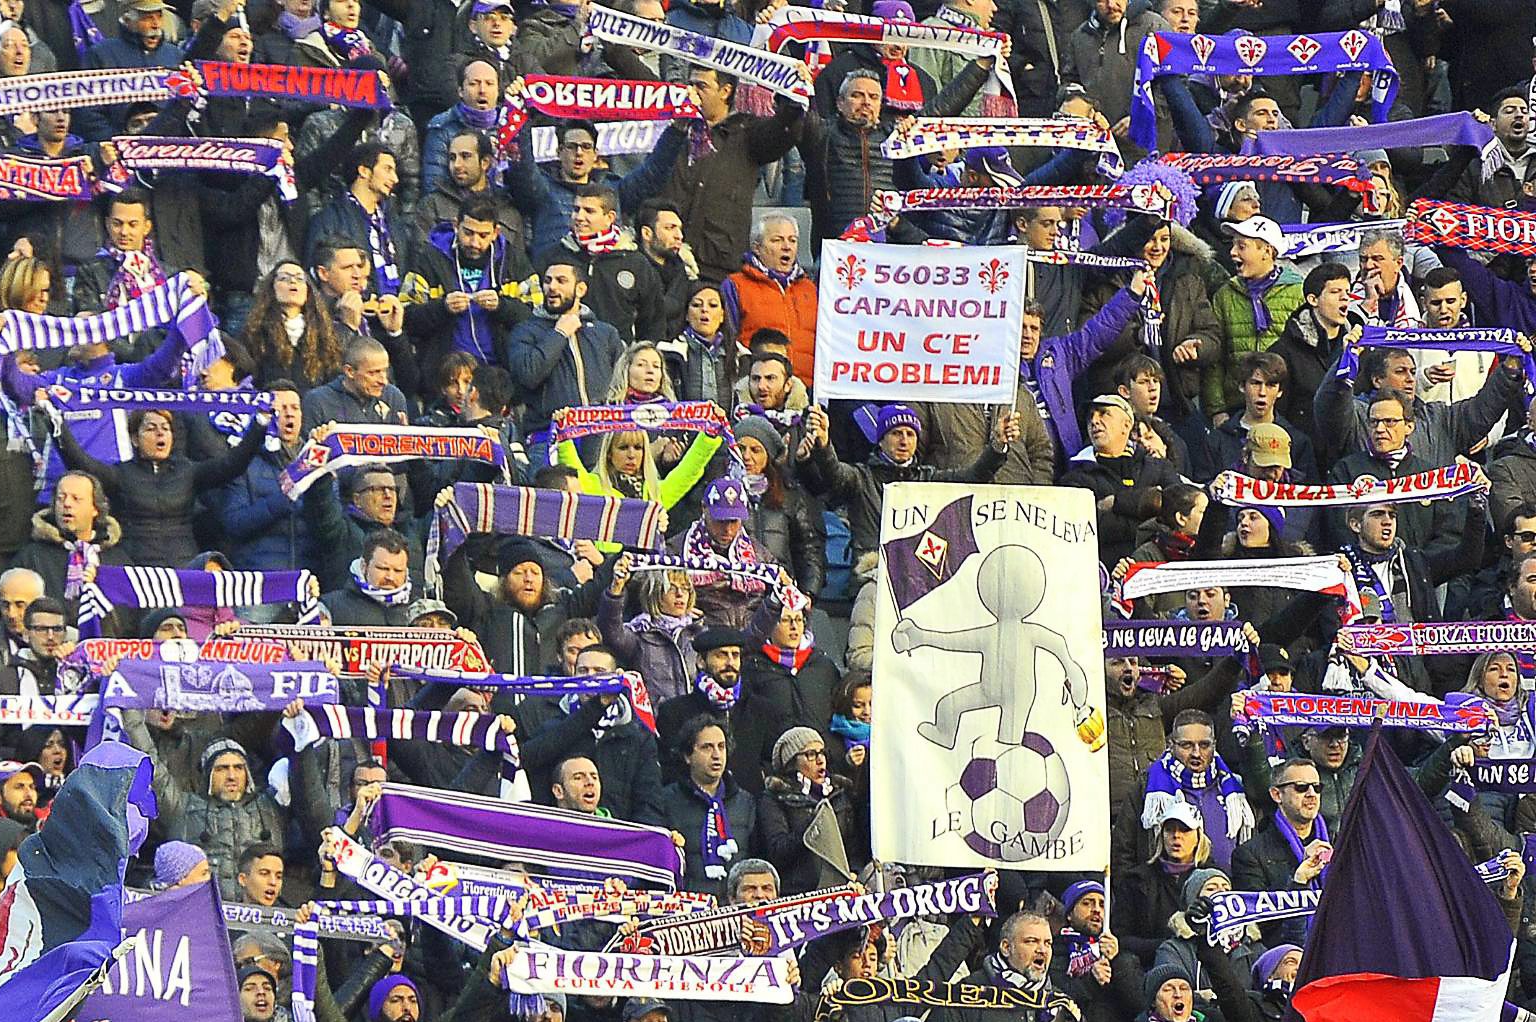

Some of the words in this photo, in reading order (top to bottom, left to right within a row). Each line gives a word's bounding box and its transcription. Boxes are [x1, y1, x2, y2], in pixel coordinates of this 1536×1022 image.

[712, 44, 799, 90] AUTONOMO
[1, 76, 156, 104] FIORENTINA
[202, 61, 377, 105] FIORENTINA
[873, 263, 970, 286] 56033
[833, 296, 1008, 319] CAPANNOLI
[857, 330, 906, 353] UN
[922, 332, 980, 356] C'E'
[830, 361, 1002, 387] PROBLEMI
[337, 433, 493, 462] FIORENTINA
[1234, 476, 1337, 500] FORZA
[1385, 461, 1472, 495] VIOLA
[892, 504, 929, 532] UN
[974, 499, 1007, 528] SE
[1014, 502, 1048, 531] NE
[1051, 513, 1096, 544] LEVA
[1113, 626, 1135, 649] NE
[1137, 626, 1176, 649] LEVA
[1178, 624, 1197, 649] LE
[1414, 626, 1473, 645] FORZA
[86, 637, 154, 664] GRUPPO
[200, 638, 289, 667] ANTIJUVE
[360, 640, 454, 673] LIVERPOOL
[1478, 766, 1504, 784] UN
[1508, 764, 1530, 785] SE
[931, 810, 962, 840] LE
[989, 819, 1085, 861] GAMBE
[461, 880, 517, 900] Fiorentina
[530, 889, 566, 912] ALE
[767, 903, 834, 949] IT'S
[833, 893, 892, 927] MY
[890, 876, 982, 917] DRUG
[526, 953, 779, 989] FIORENZA
[554, 977, 635, 992] CURVA
[653, 980, 755, 994] FIESOLE
